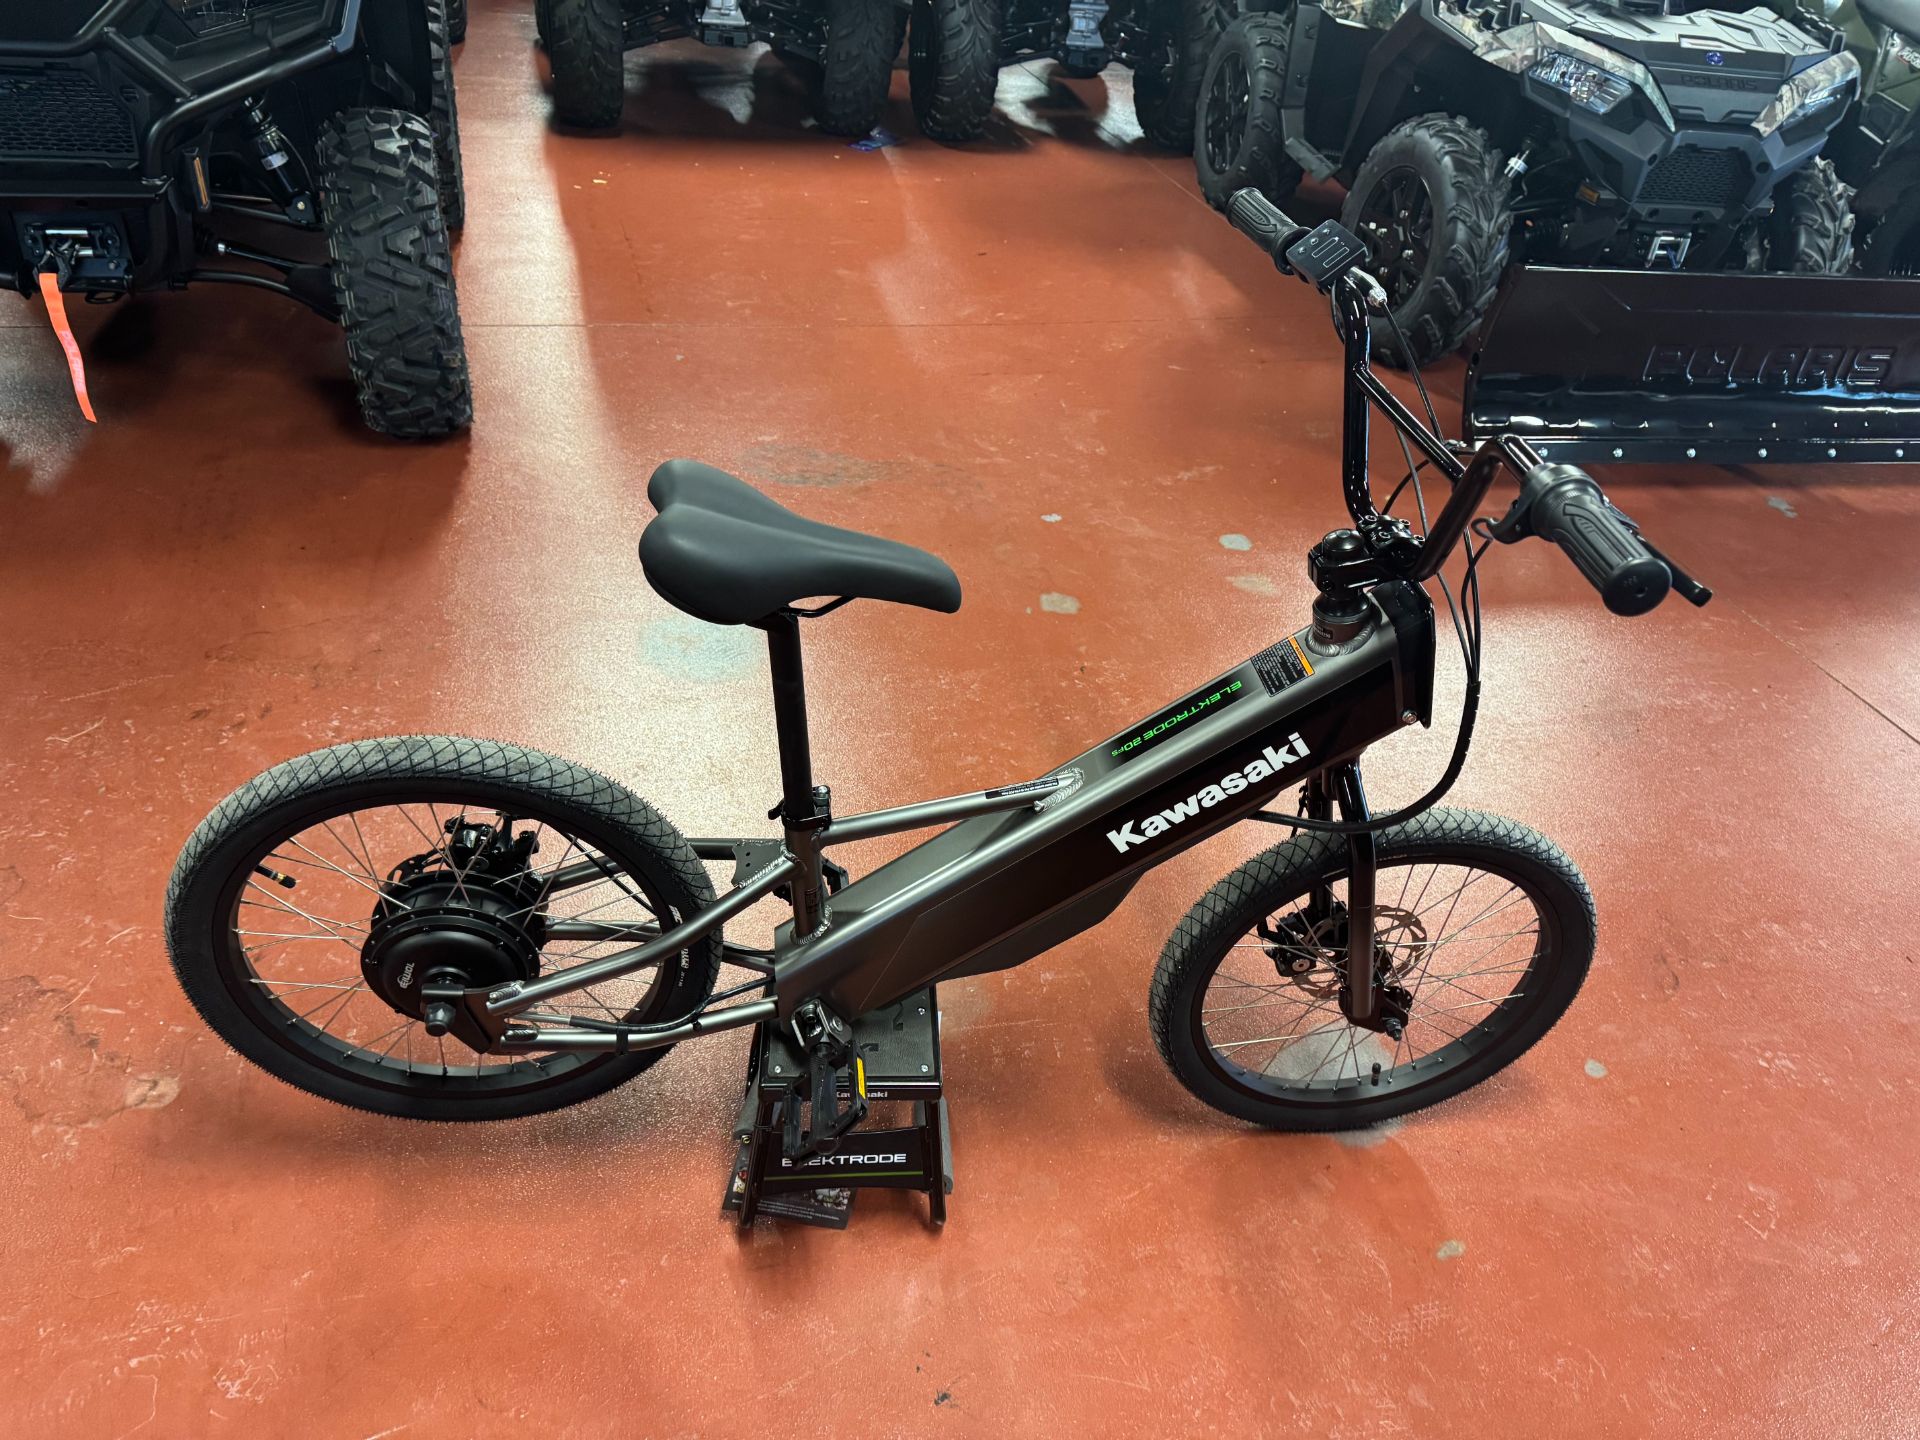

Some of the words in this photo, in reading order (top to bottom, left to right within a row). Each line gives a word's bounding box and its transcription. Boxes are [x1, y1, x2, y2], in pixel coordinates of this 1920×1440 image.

[1680, 74, 1758, 90] POLARIS
[1642, 344, 1896, 385] POLARIS
[1142, 680, 1243, 741] ELEKTRODE
[1106, 732, 1311, 853] Kawasaki
[781, 1153, 907, 1167] EEKTRODE
